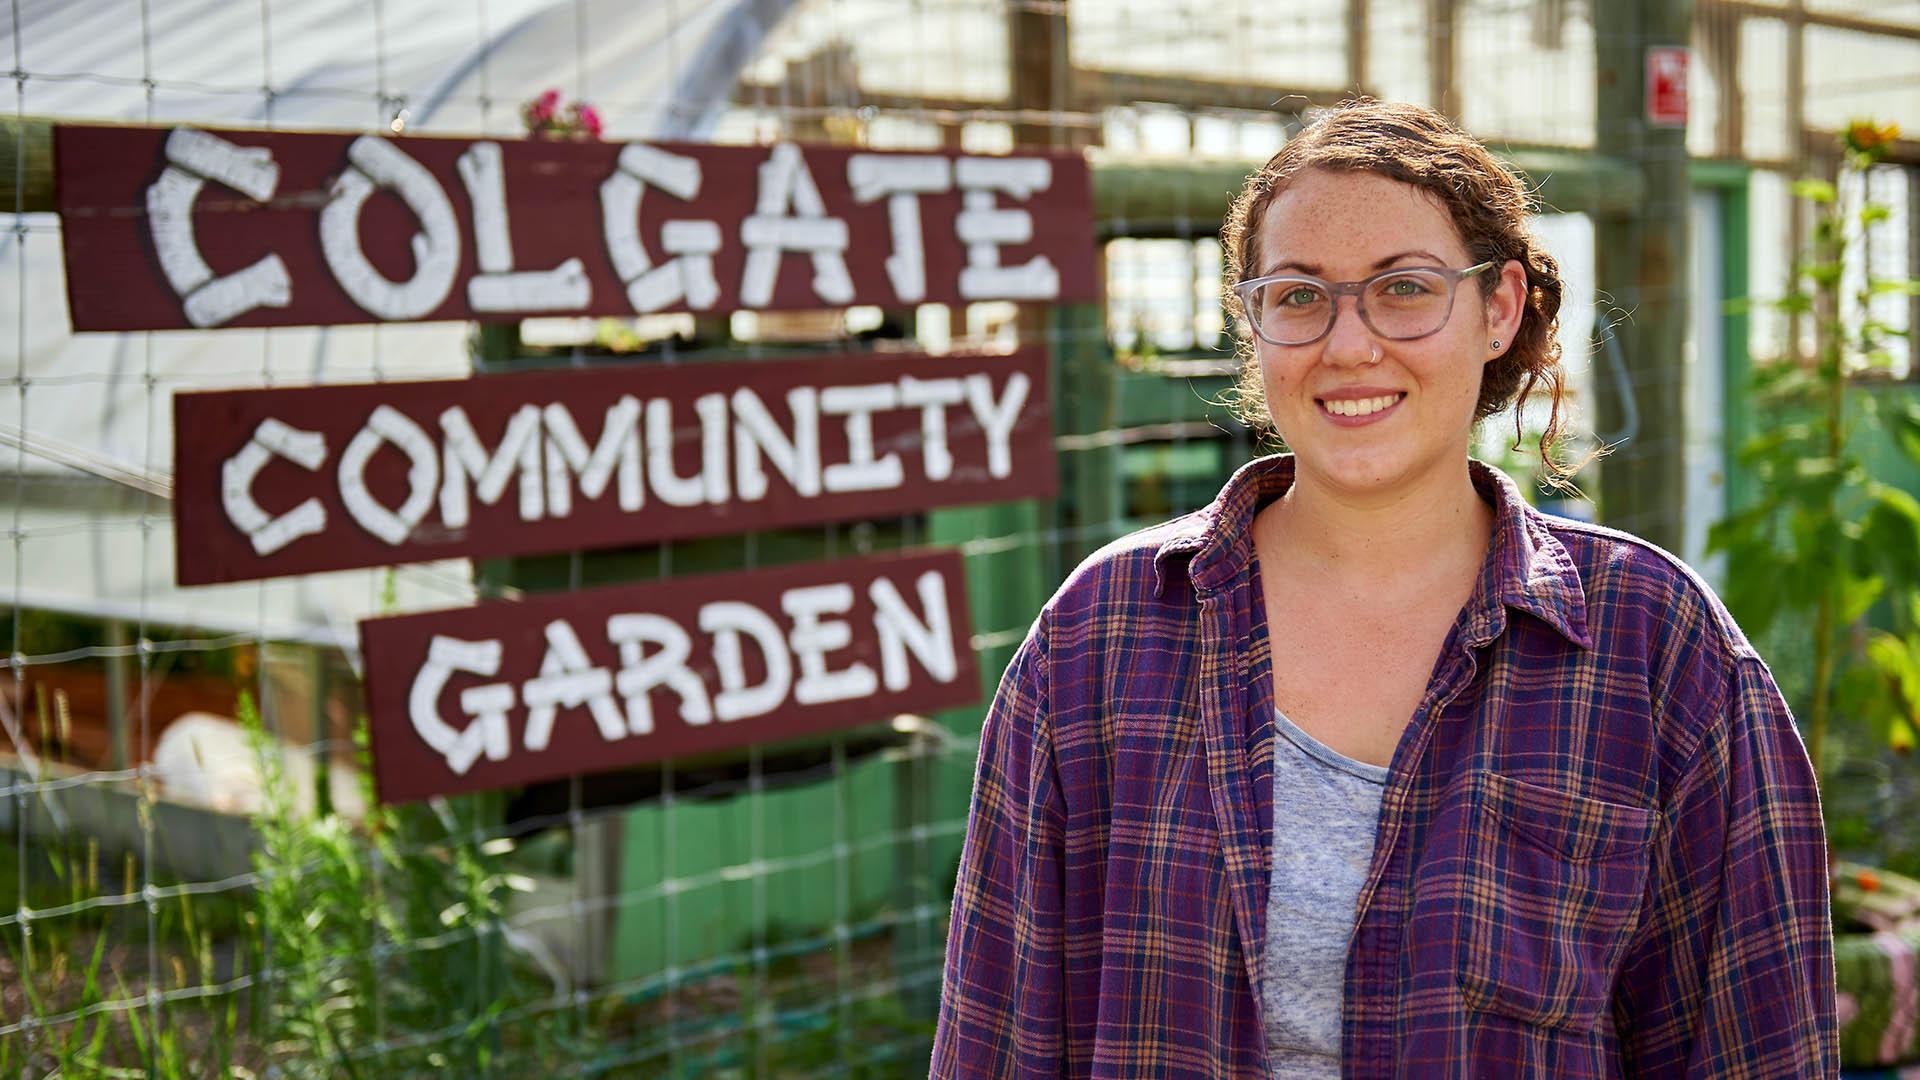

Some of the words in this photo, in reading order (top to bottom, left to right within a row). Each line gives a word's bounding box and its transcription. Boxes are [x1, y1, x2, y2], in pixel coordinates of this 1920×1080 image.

[146, 126, 1060, 327] COLGATE
[222, 372, 1029, 556] COMMUNITY
[409, 570, 957, 774] GARDEN
